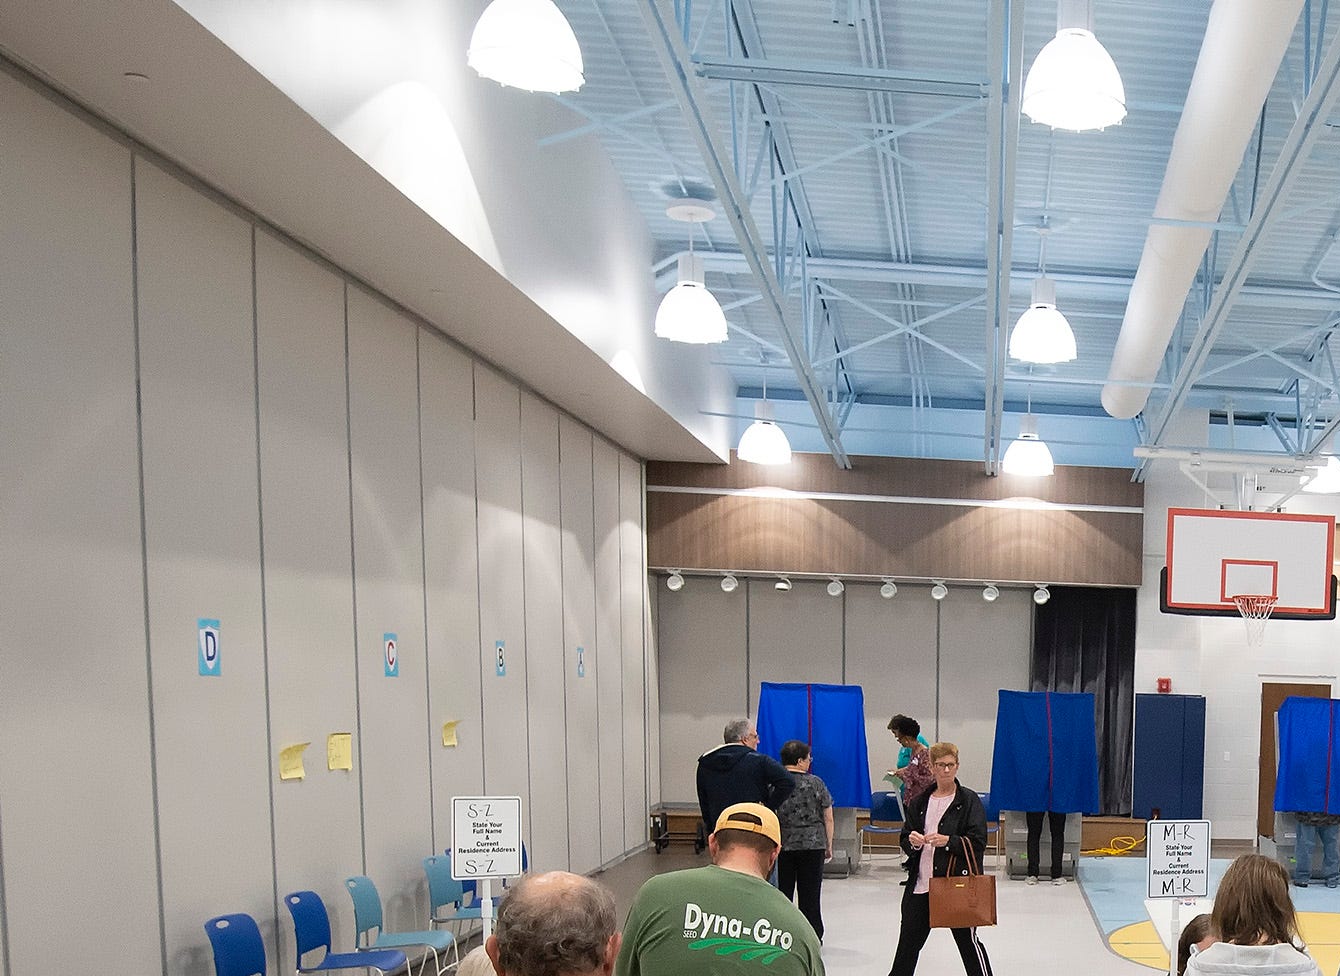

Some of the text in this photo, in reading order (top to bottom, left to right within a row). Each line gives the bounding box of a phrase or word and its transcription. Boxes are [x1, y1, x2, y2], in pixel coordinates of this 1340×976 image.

[205, 631, 216, 661] D
[387, 641, 395, 665] C
[467, 803, 494, 818] S-Z
[1163, 824, 1195, 841] M-R
[465, 859, 496, 874] S-Z
[1162, 878, 1194, 895] M-R
[684, 902, 793, 951] Dyna-Gro
